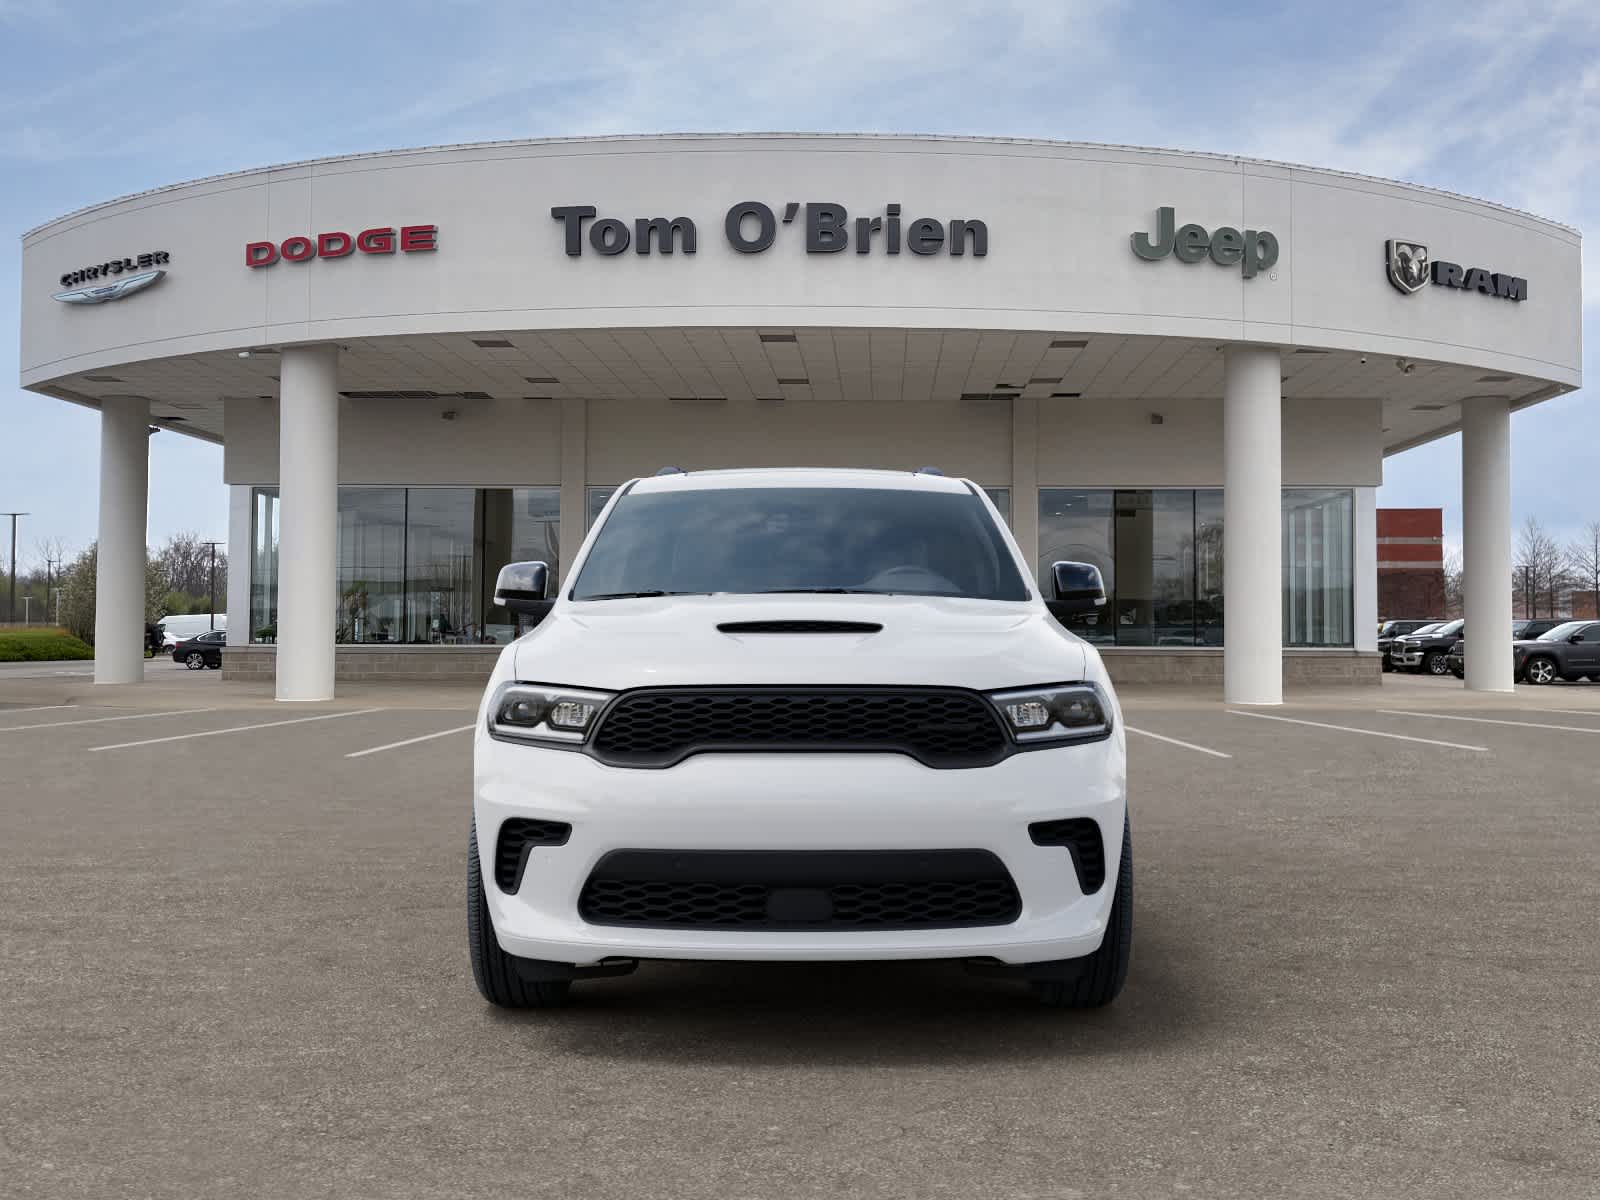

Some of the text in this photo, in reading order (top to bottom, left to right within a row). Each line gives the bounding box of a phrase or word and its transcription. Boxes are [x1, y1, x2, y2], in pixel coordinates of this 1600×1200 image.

[245, 224, 438, 269] DODGE
[551, 205, 697, 256] Tom
[1130, 206, 1280, 280] Jeep
[60, 250, 170, 287] CHRYSLER
[1431, 260, 1528, 302] RAM
